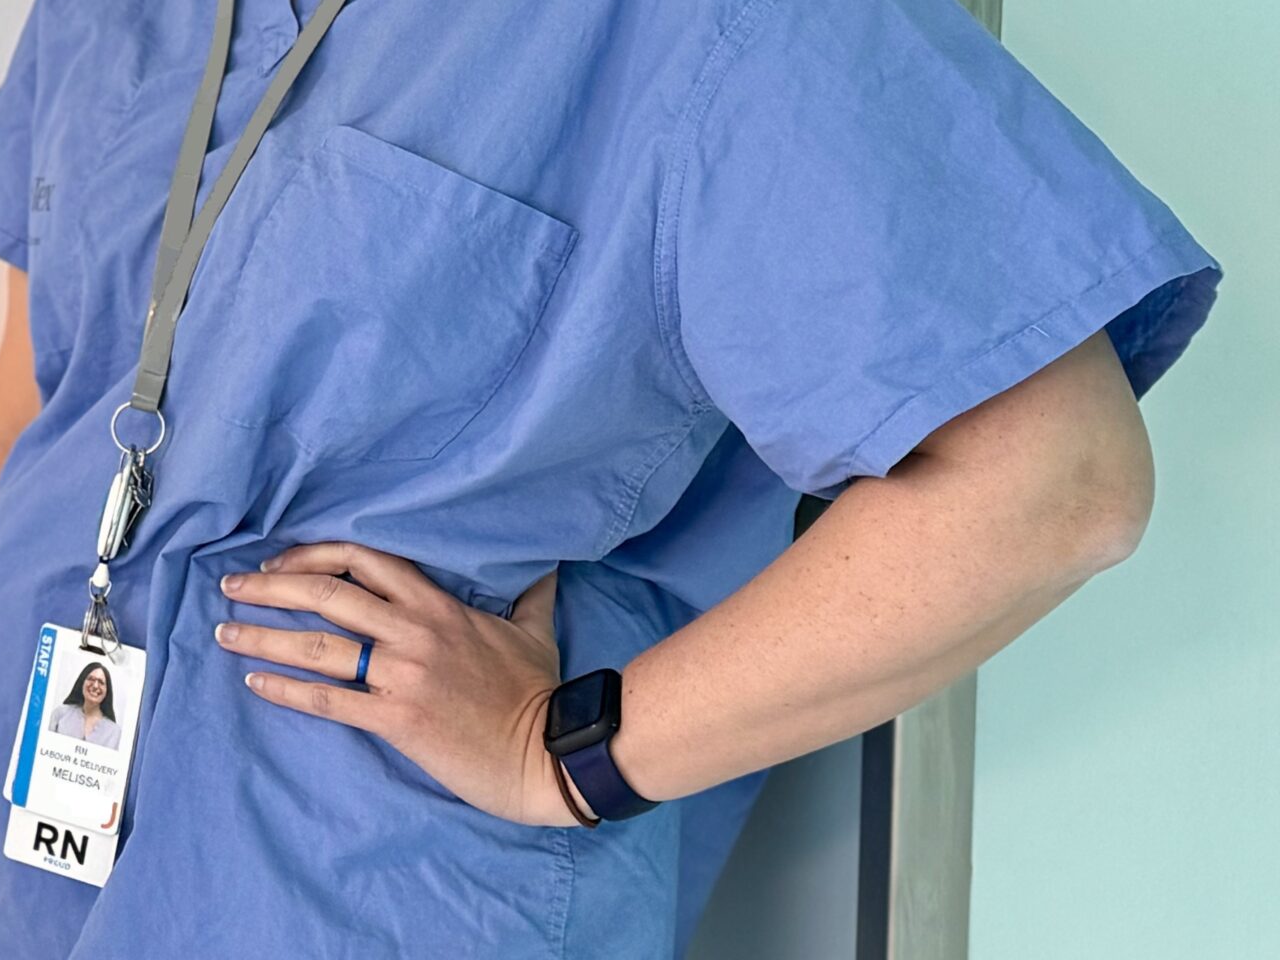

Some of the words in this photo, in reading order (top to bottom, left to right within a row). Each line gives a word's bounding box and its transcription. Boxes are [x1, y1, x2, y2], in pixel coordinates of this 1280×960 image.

[37, 634, 53, 678] STAFF
[40, 747, 71, 763] LABOUR
[73, 757, 78, 766] &
[80, 759, 118, 776] DELIVERY
[52, 766, 100, 790] MELISSA
[33, 821, 89, 866] RN
